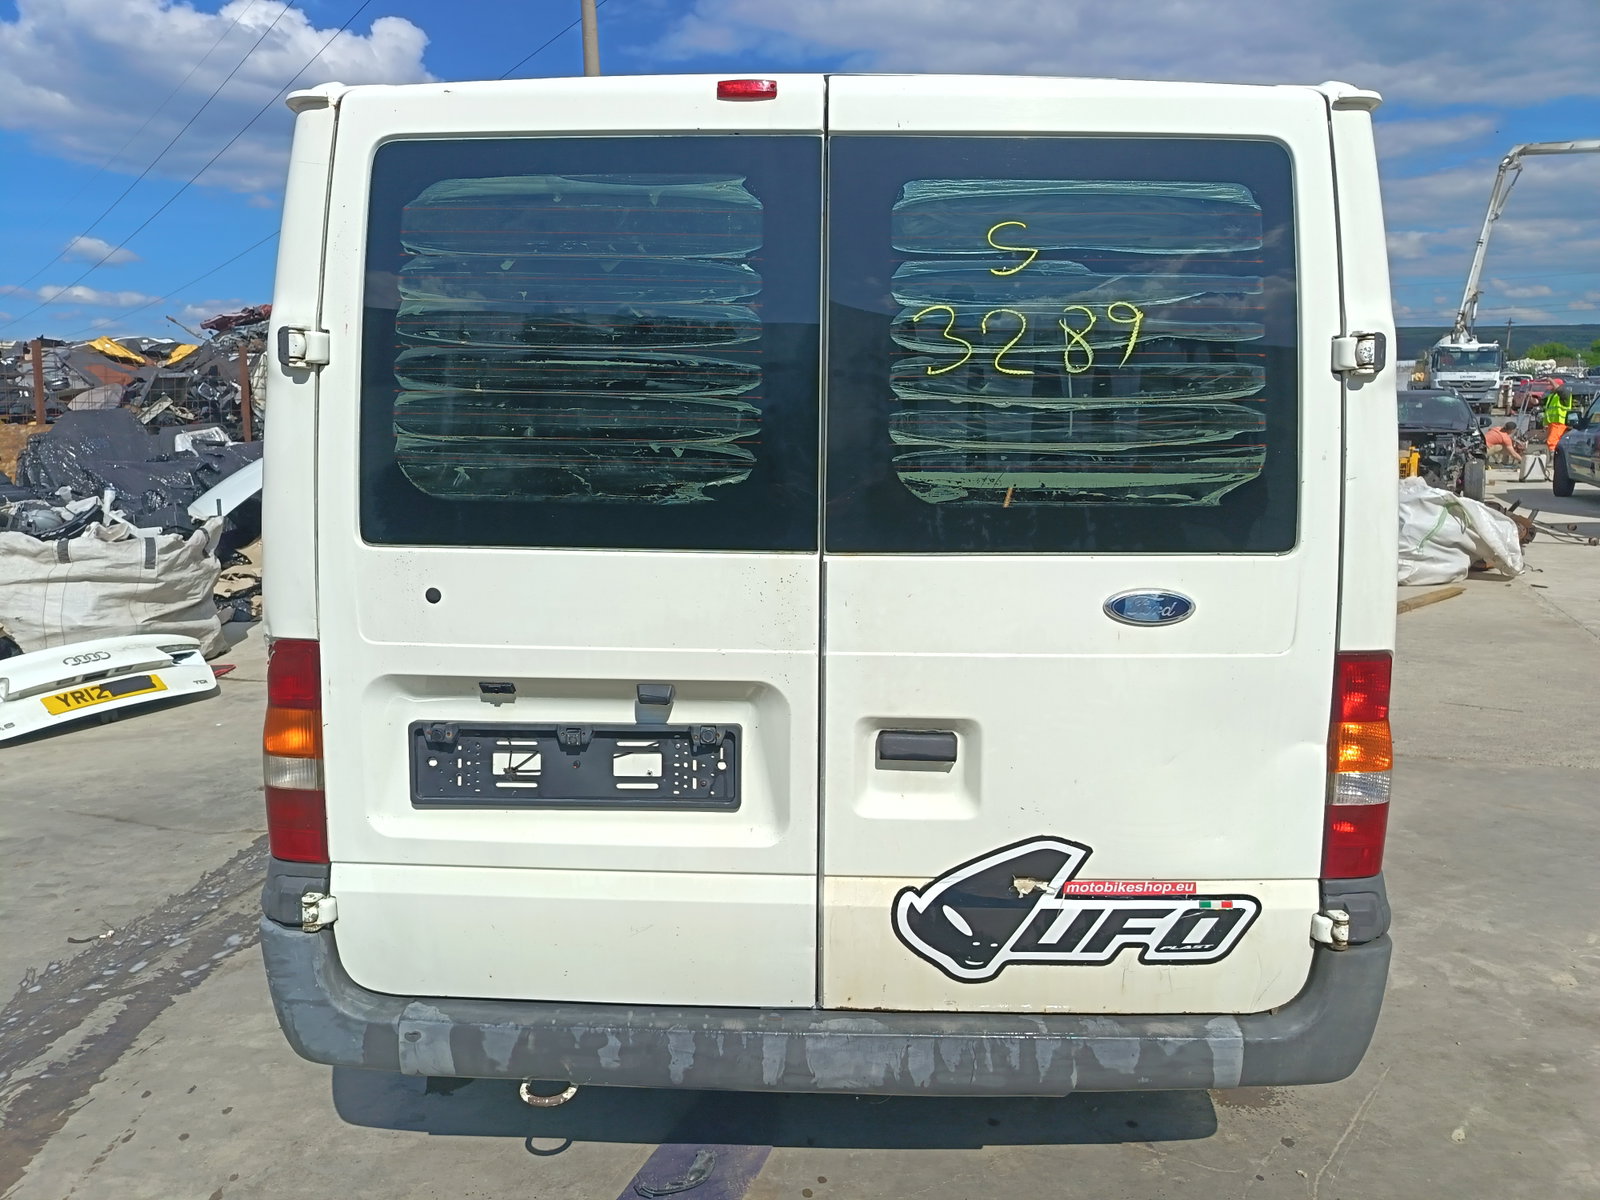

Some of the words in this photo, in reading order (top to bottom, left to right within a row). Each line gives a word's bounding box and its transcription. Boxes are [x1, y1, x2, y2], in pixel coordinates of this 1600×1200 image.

[912, 301, 1144, 375] 3289
[56, 686, 109, 707] YR12
[1066, 882, 1194, 894] motobikeshop.eu
[1009, 908, 1247, 953] UFO
